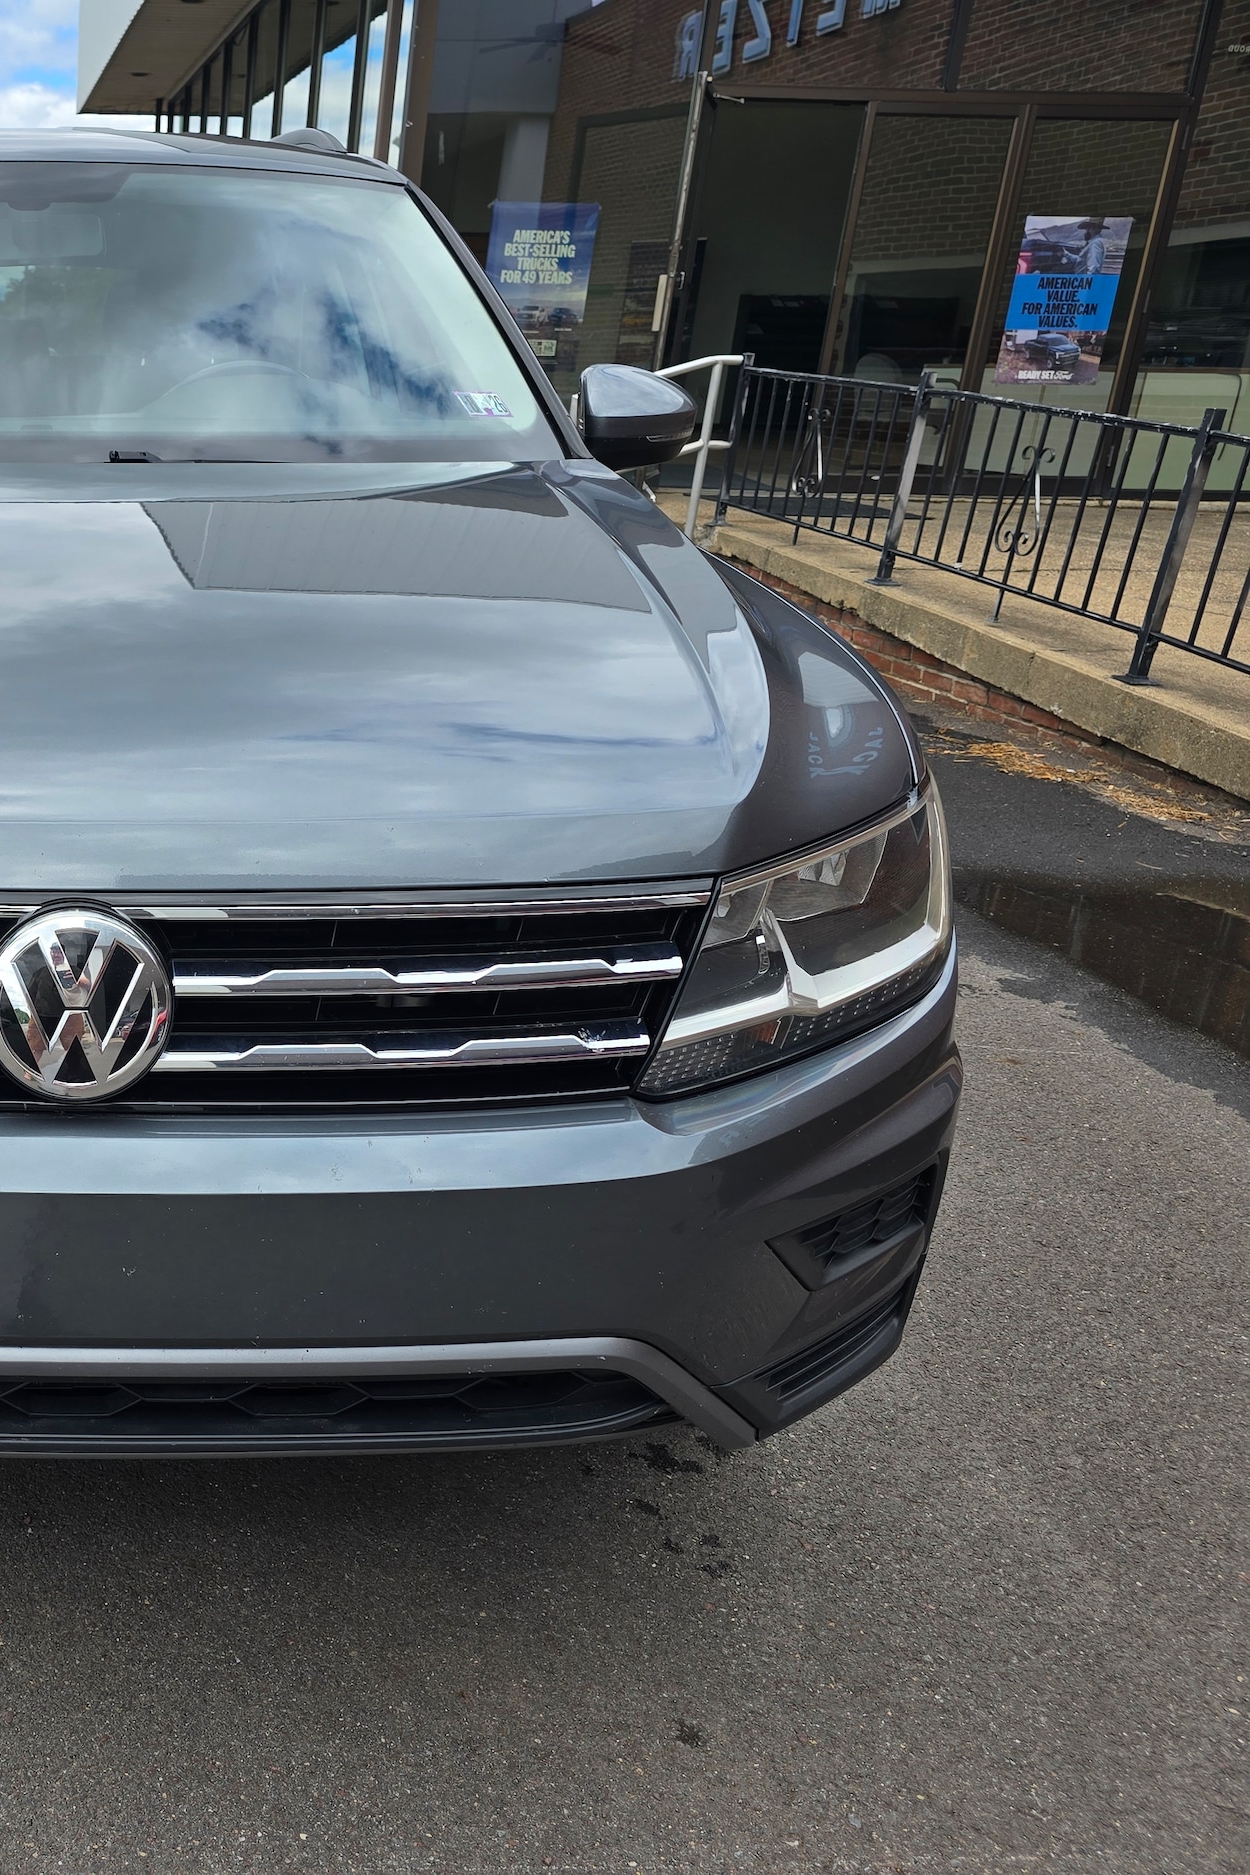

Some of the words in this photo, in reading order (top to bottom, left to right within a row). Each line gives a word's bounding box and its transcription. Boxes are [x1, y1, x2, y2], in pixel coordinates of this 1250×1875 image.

[513, 229, 570, 243] AMERICA'S
[504, 243, 576, 258] BEST-SELLING
[517, 257, 558, 270] TRUCKS
[501, 270, 521, 283] FOR
[522, 271, 536, 284] 49
[538, 271, 573, 284] YEARS
[1037, 277, 1093, 290] AMERICAN
[1047, 290, 1080, 303] VALUE.
[1021, 303, 1041, 315] FOR
[1043, 303, 1098, 315] AMERICAN
[1038, 315, 1078, 328] VALUES.
[1018, 370, 1041, 380] READY
[1041, 370, 1055, 380] SET
